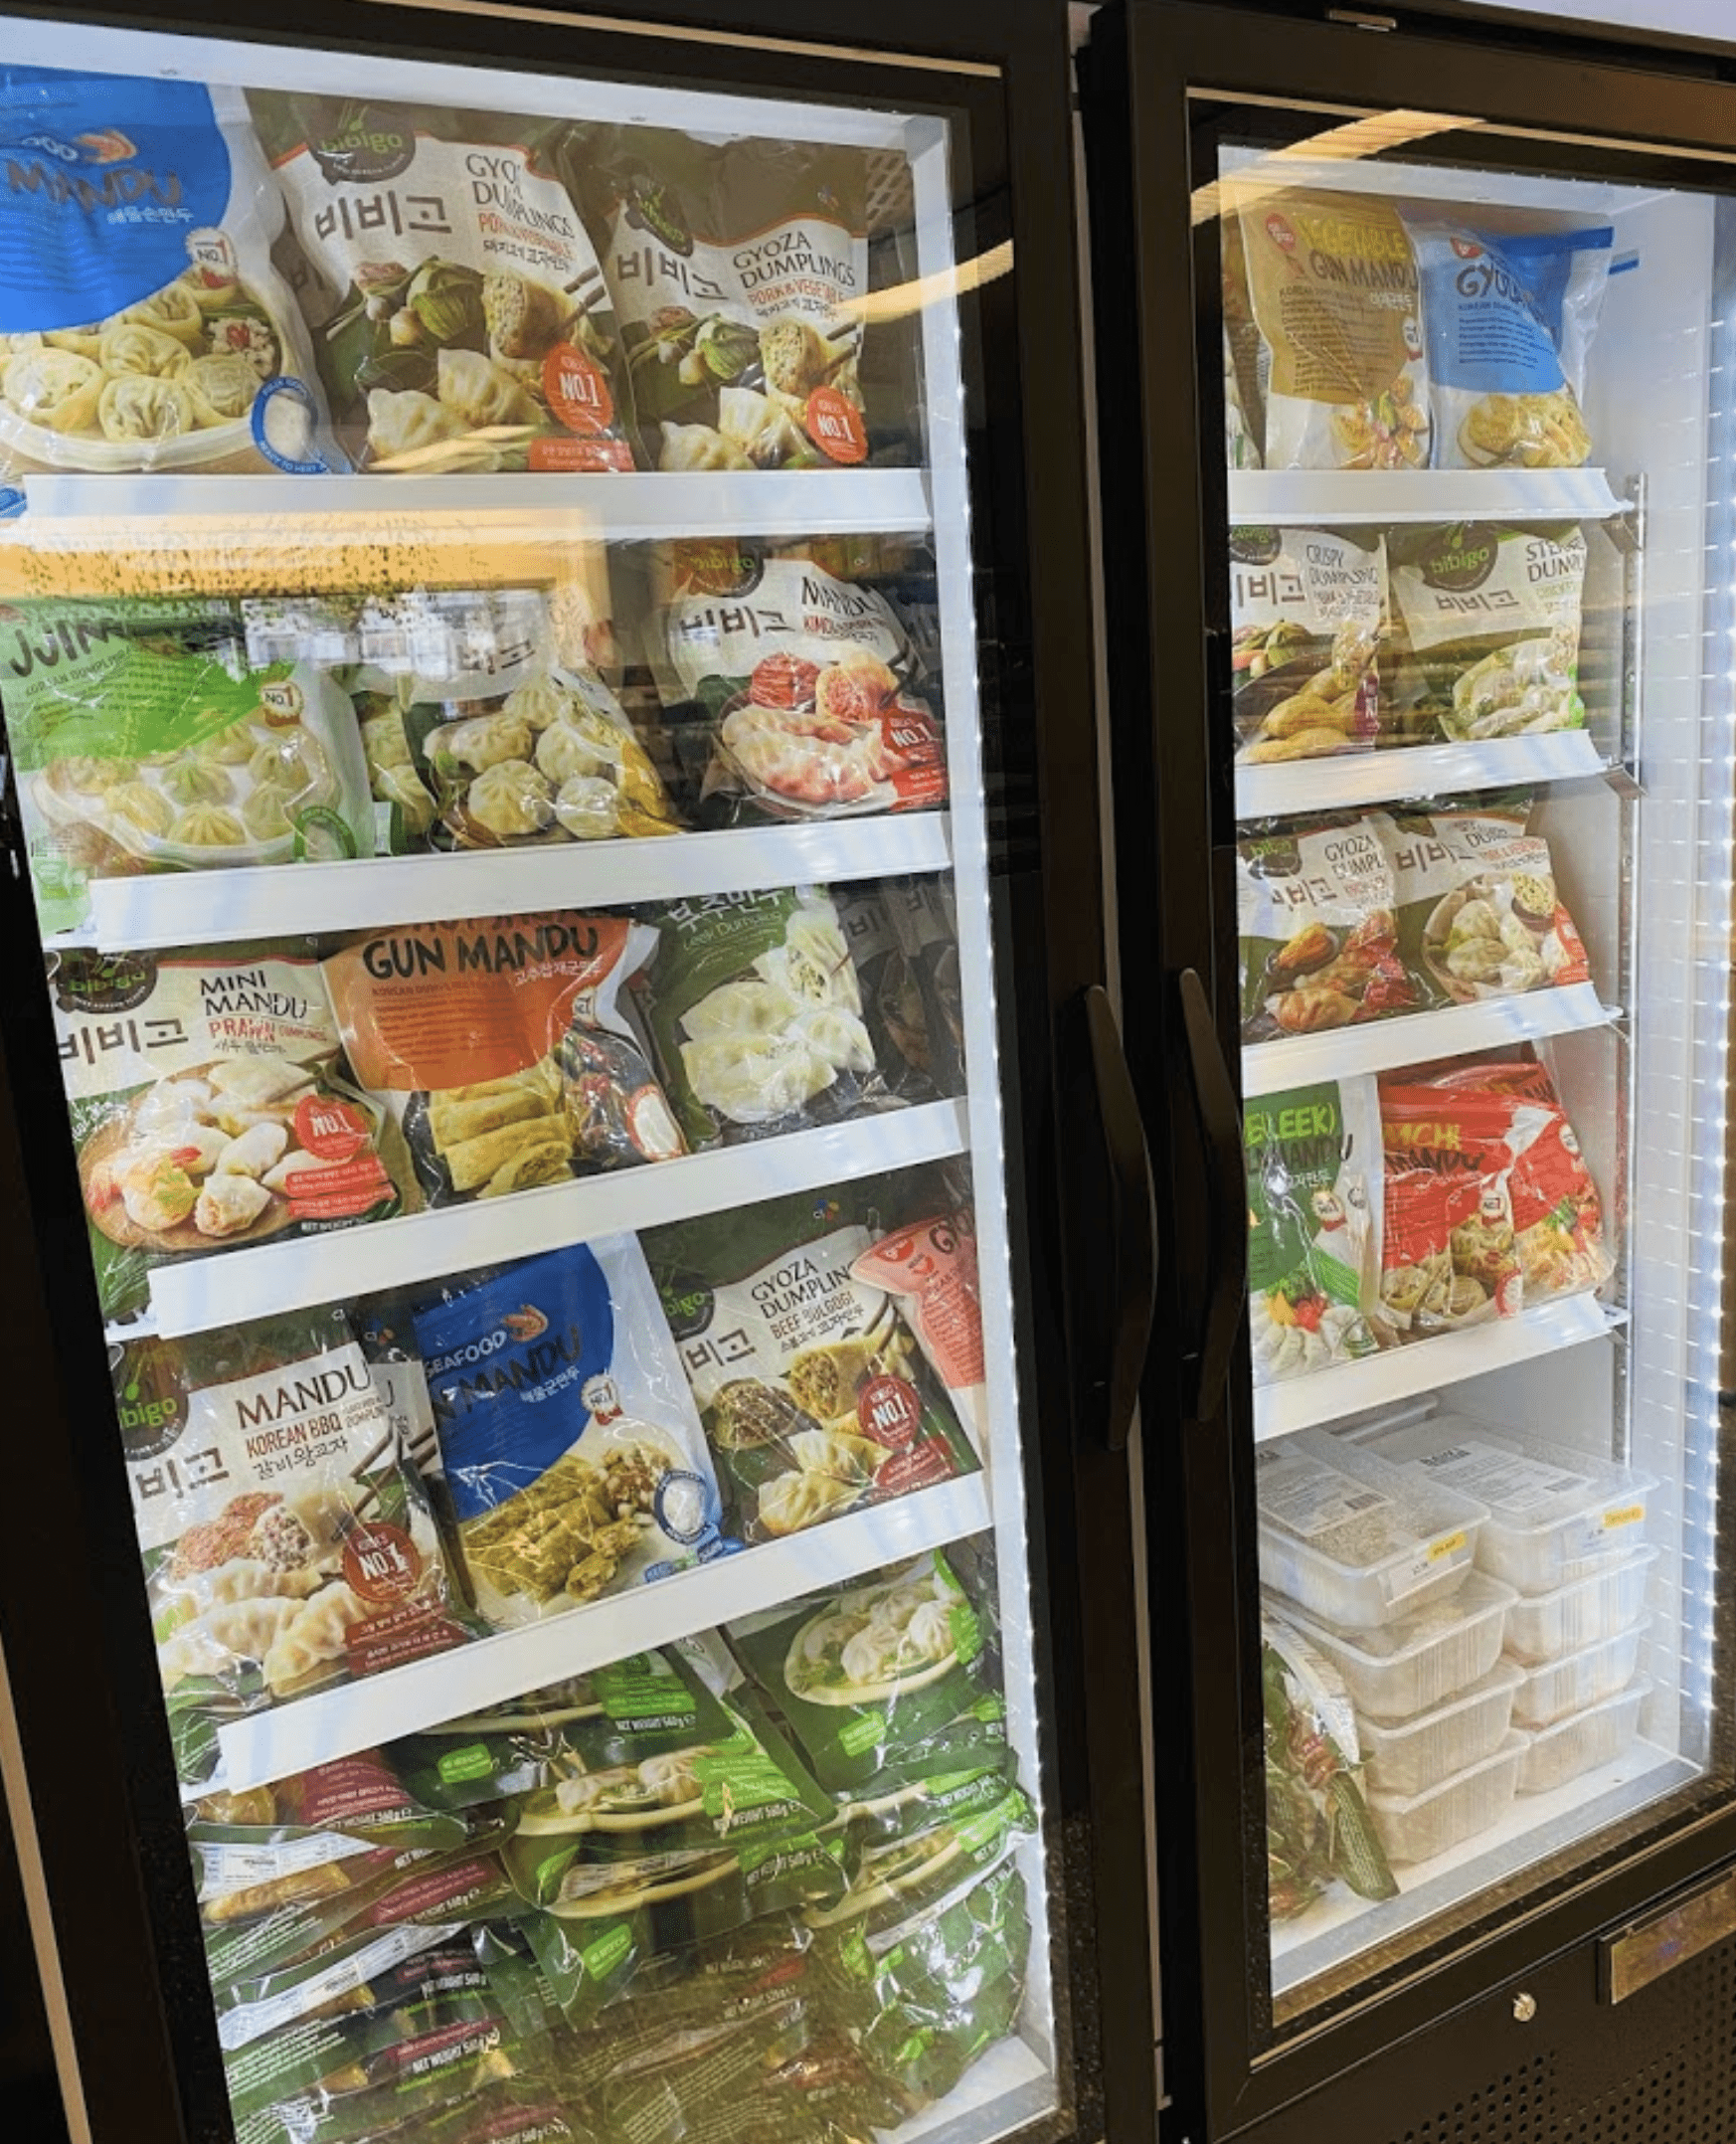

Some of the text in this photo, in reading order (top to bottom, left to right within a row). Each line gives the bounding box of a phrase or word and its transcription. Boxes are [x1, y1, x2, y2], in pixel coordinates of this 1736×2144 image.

[7, 159, 183, 215] MANDU
[315, 190, 452, 241] 비비고
[733, 231, 812, 269] GYOZA
[616, 246, 730, 300] 비비고
[740, 253, 856, 289] DUMPLINGS
[559, 371, 602, 408] NO.1
[816, 412, 859, 444] NO.1
[1429, 546, 1490, 575] bibigo
[1434, 589, 1521, 615] 비비고
[889, 722, 943, 748] NO.1
[1324, 834, 1376, 862] GYOZA
[1331, 851, 1385, 880] DUMPL
[362, 923, 600, 980] GUN MANDU
[200, 969, 266, 997] MINI
[205, 991, 307, 1019] MANDU
[58, 1018, 189, 1065] 비비고
[209, 1017, 276, 1043] PRAWN
[309, 1107, 355, 1138] NO.1
[751, 1257, 819, 1302] GYOZA
[760, 1258, 857, 1320] DUMPLIN
[770, 1291, 855, 1340] BEEF BULGOGI
[426, 1330, 507, 1378] SEAFOOD
[685, 1328, 757, 1370] 비고
[119, 1396, 178, 1430] bigo
[236, 1359, 373, 1430] MANDU
[871, 1392, 910, 1431] NO.1
[246, 1412, 344, 1460] KOREAN BBQ
[135, 1447, 230, 1500] 비고
[358, 1541, 411, 1581] NO.1
